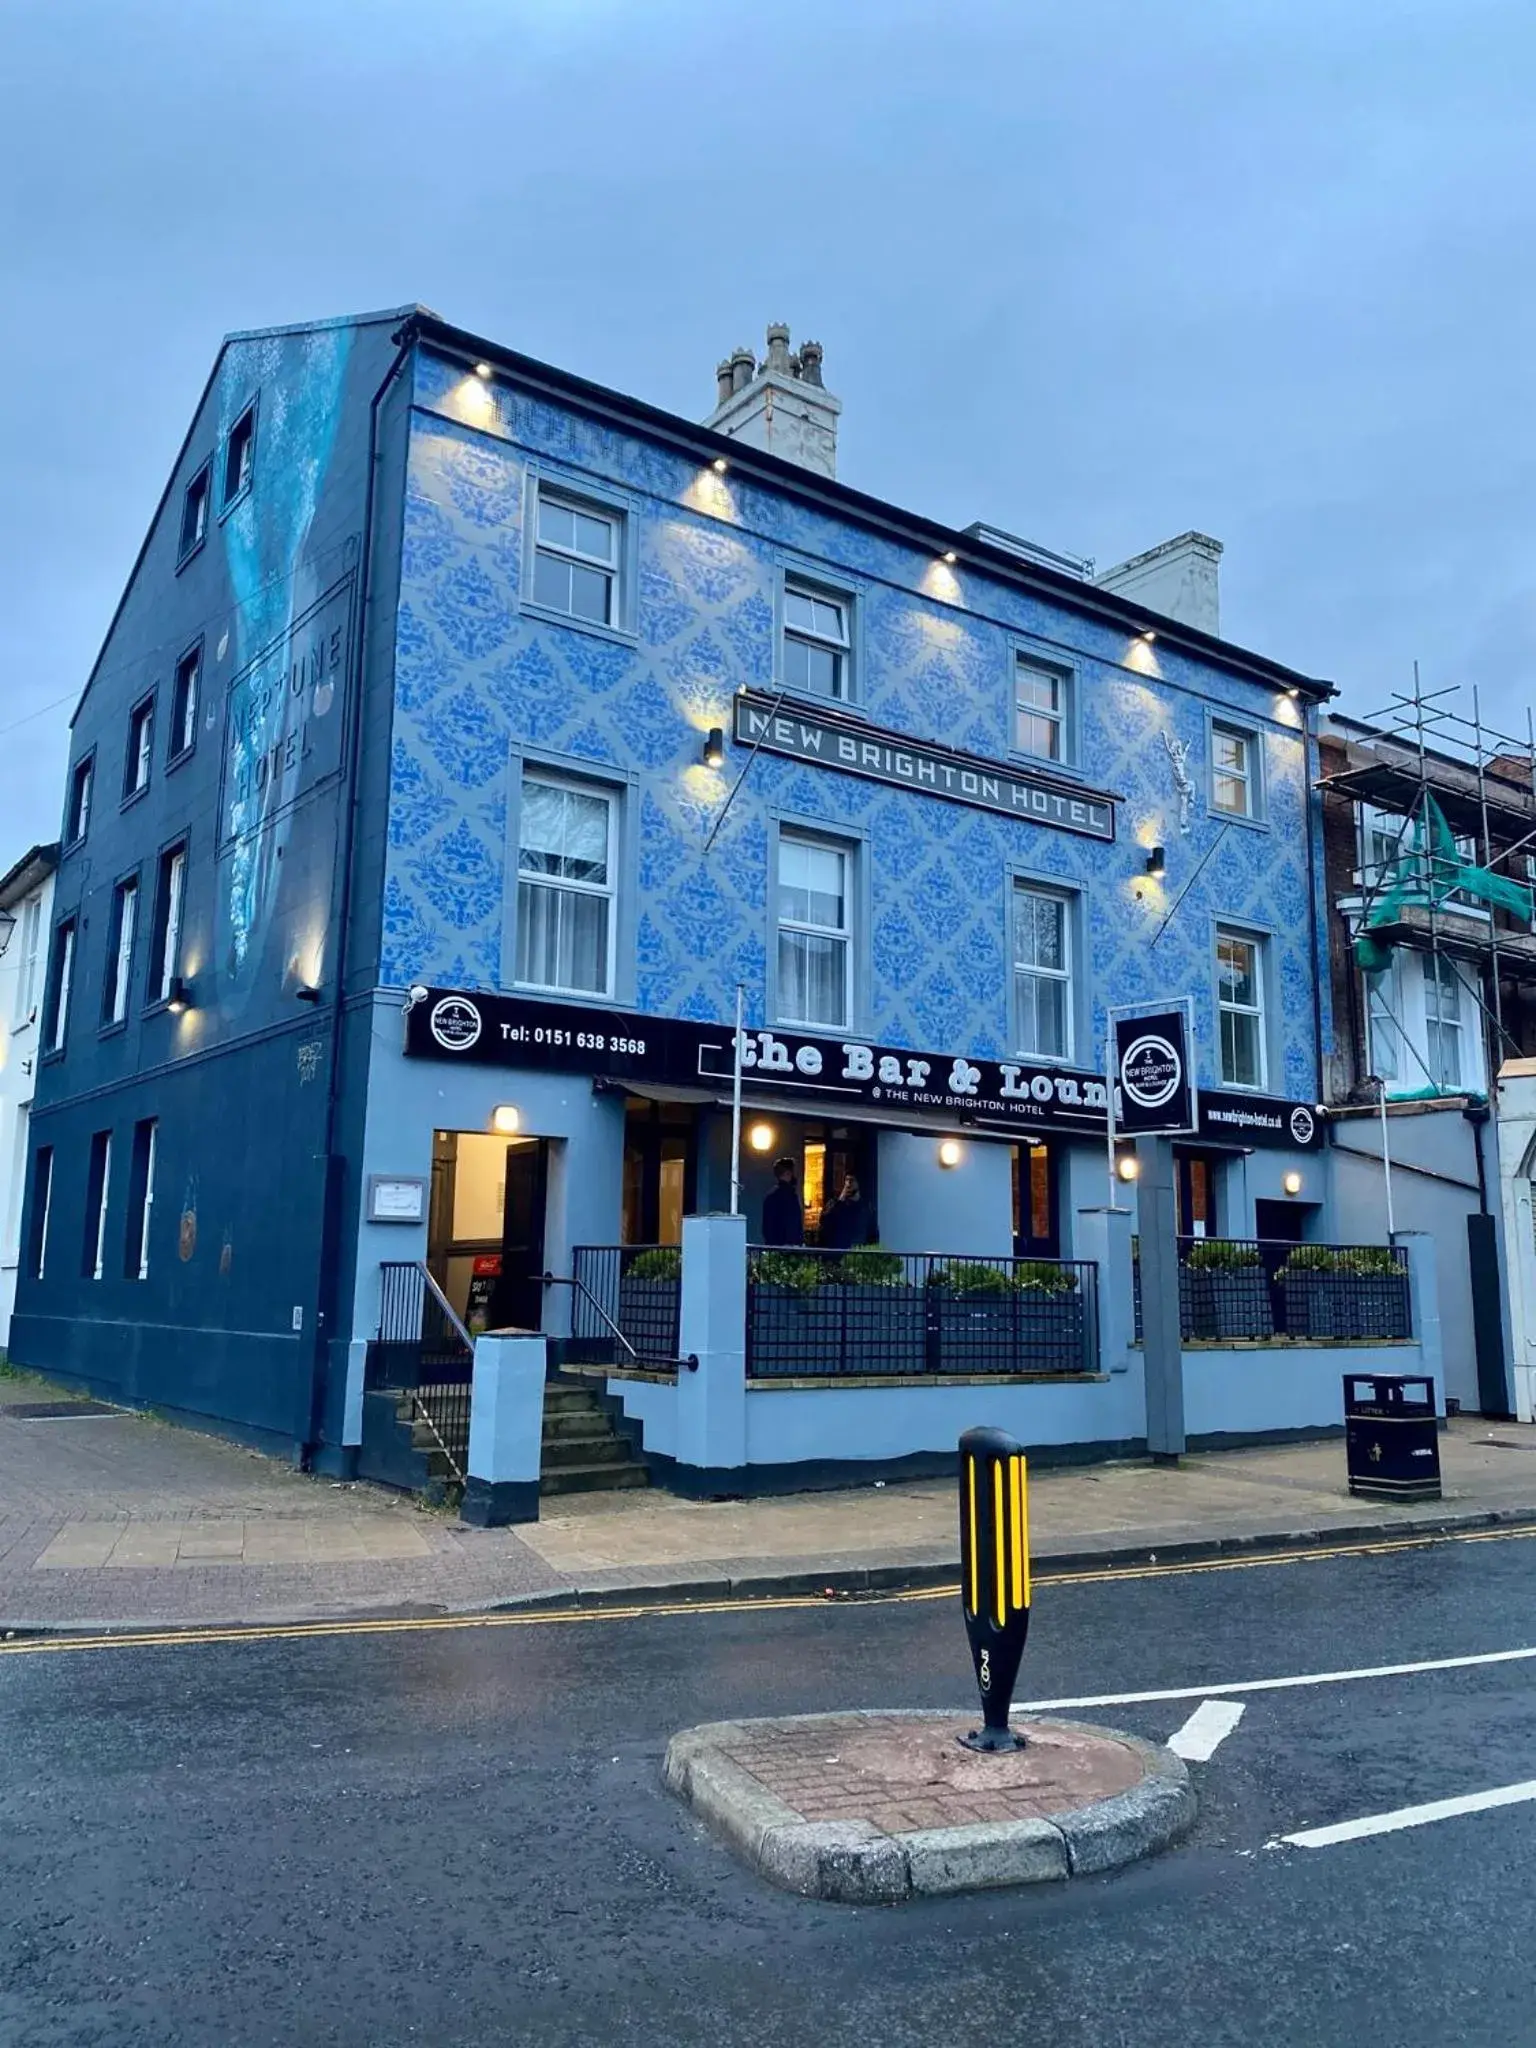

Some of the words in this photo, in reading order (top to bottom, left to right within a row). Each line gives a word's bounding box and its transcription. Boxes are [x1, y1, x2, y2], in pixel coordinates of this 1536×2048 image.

[230, 624, 342, 750] NEPTUNE
[239, 721, 312, 801] HOTEL
[749, 709, 823, 752] NEW
[838, 736, 999, 801] BRIGHTON
[1011, 784, 1105, 829] HOTEL
[500, 1023, 531, 1042] Tel:
[534, 1027, 571, 1046] 0151
[576, 1032, 605, 1050] 638
[609, 1036, 646, 1055] 3568
[731, 1030, 823, 1075] the
[841, 1043, 931, 1087] Bar
[949, 1058, 982, 1095] &
[999, 1064, 1123, 1116] Loun
[1125, 1067, 1139, 1077] NEW
[1140, 1063, 1177, 1077] BRIGHTON
[885, 1089, 909, 1100] THE
[914, 1092, 943, 1104] NEW
[945, 1096, 1005, 1111] BRIGHTON
[1009, 1103, 1045, 1115] HOTEL
